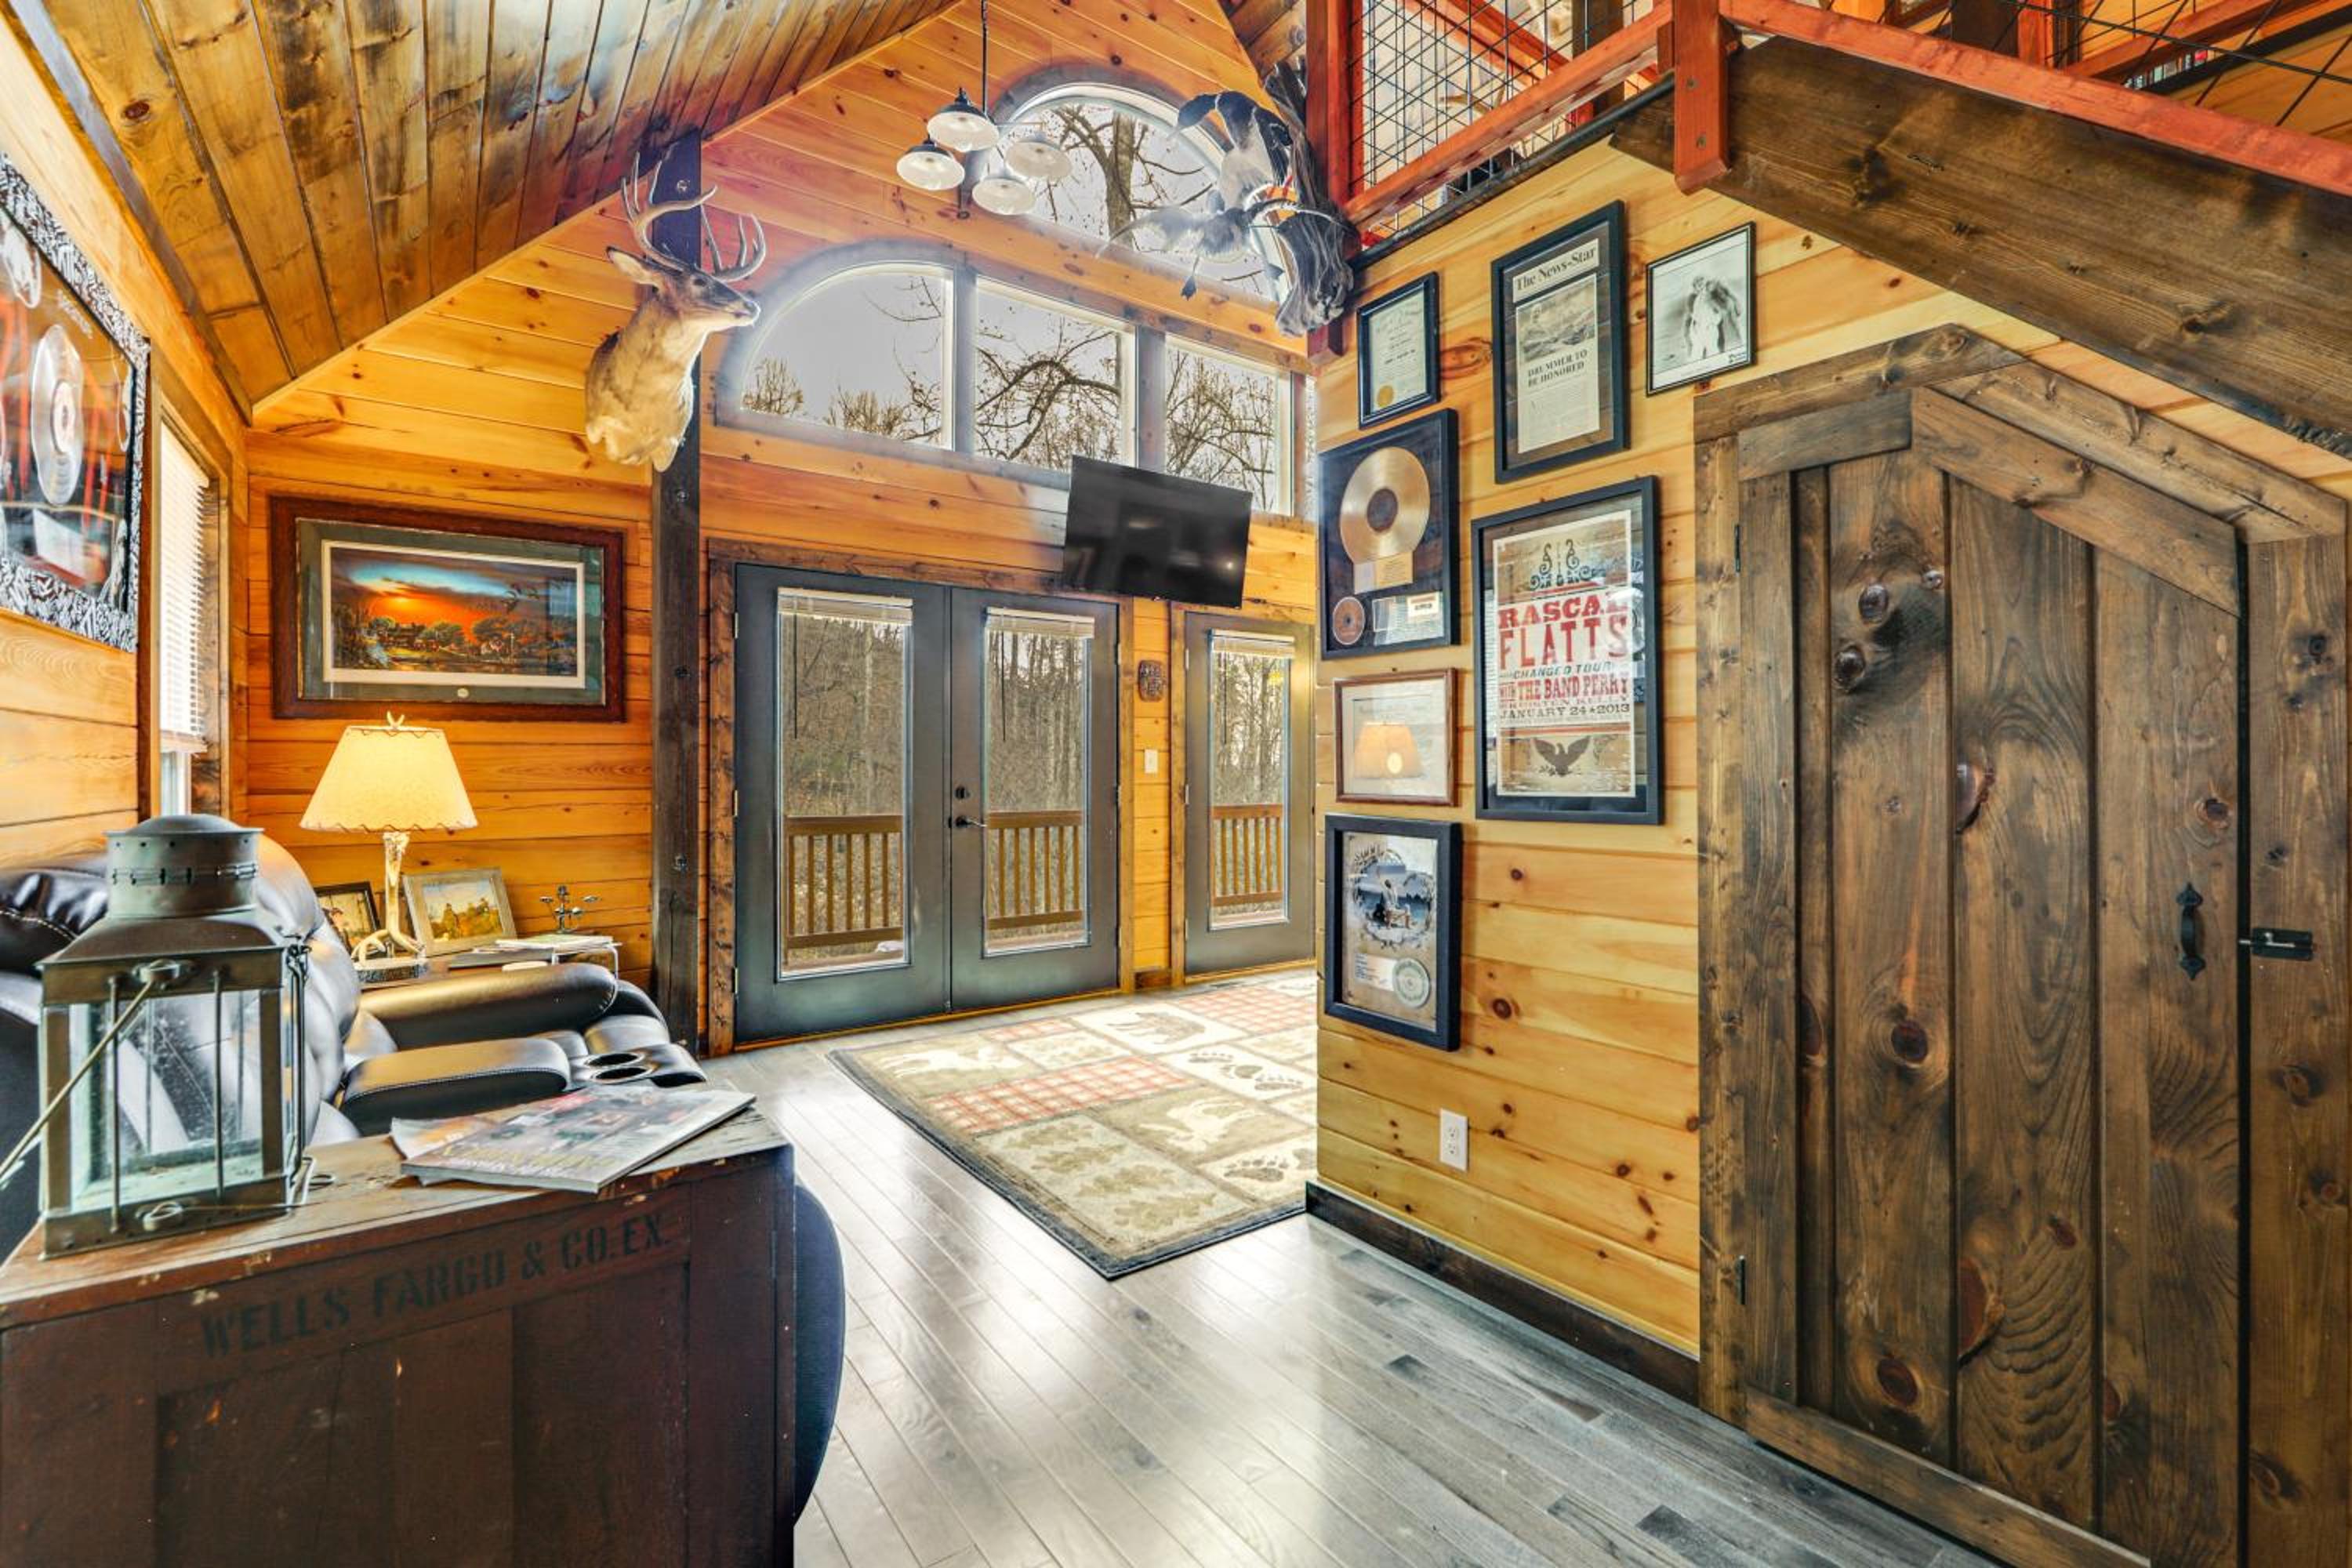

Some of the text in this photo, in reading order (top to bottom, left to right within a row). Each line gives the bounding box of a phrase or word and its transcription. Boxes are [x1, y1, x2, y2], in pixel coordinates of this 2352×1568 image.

[1516, 247, 1596, 291] The News-Star
[1528, 349, 1588, 377] DRUMMER TO
[1541, 362, 1585, 383] HONORED
[1498, 593, 1628, 629] RASCAL
[1500, 614, 1628, 670] FLATTS
[1517, 679, 1541, 701] THE
[1544, 675, 1581, 699] BAND
[1583, 673, 1629, 696] PERRY
[1499, 706, 1566, 720] JANUARY
[1570, 706, 1587, 716] 24
[1595, 703, 1631, 714] 2013
[201, 1286, 350, 1358] WELLS
[372, 1247, 507, 1319] FARGO
[521, 1241, 547, 1280] &
